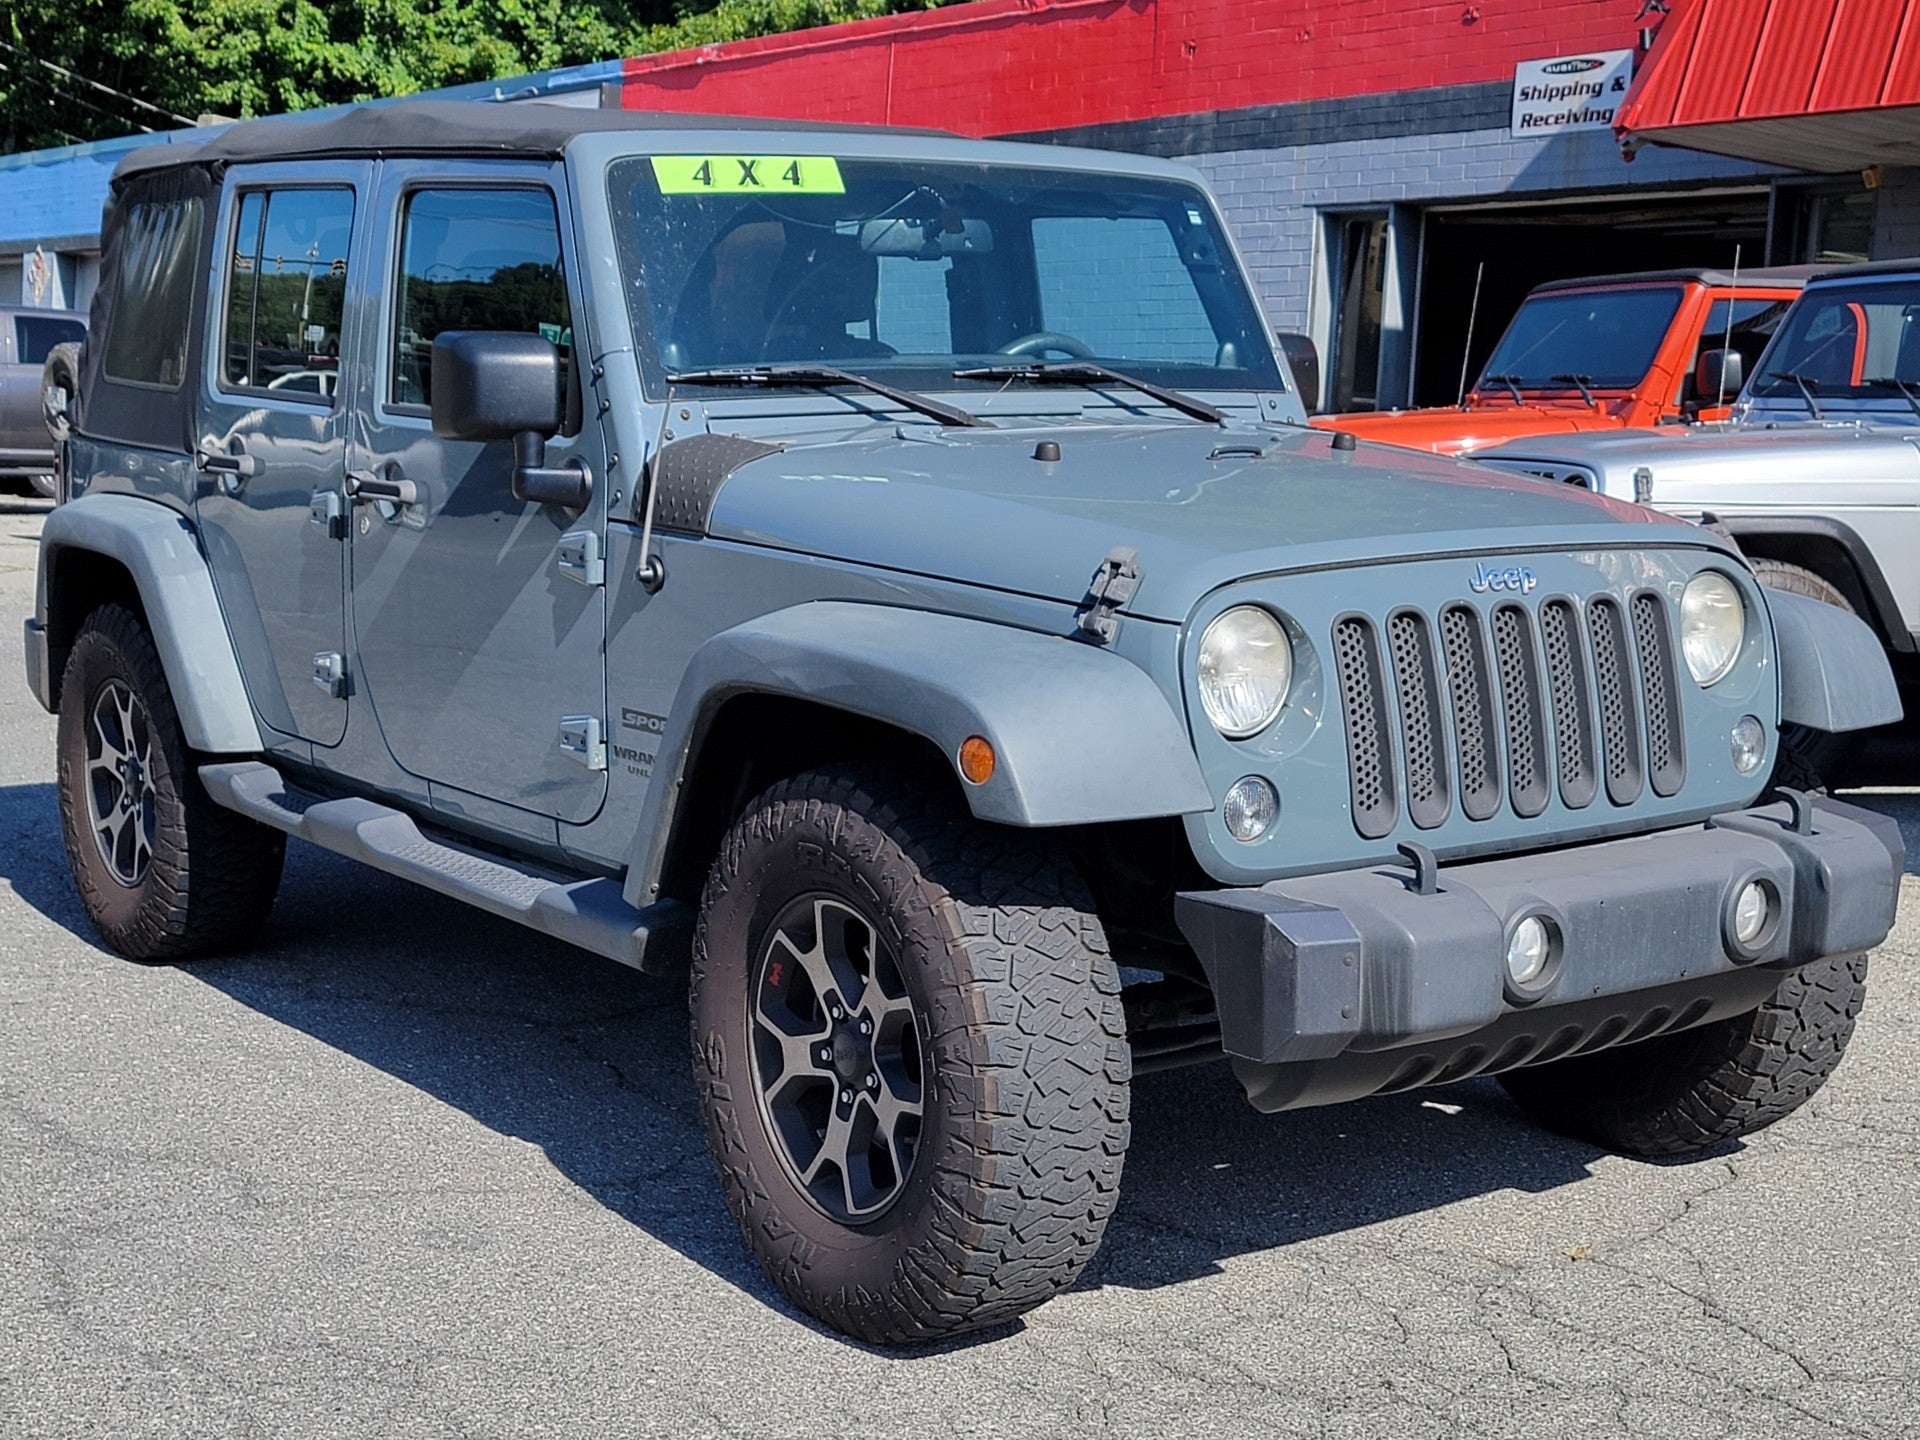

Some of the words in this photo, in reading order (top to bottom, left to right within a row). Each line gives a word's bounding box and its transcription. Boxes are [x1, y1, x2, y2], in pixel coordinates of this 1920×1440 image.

[1518, 81, 1604, 102] Shipping
[1610, 75, 1625, 92] &
[1520, 107, 1615, 128] Receiving
[692, 160, 713, 186] 4
[782, 160, 802, 186] 4
[1468, 562, 1537, 595] Jeep
